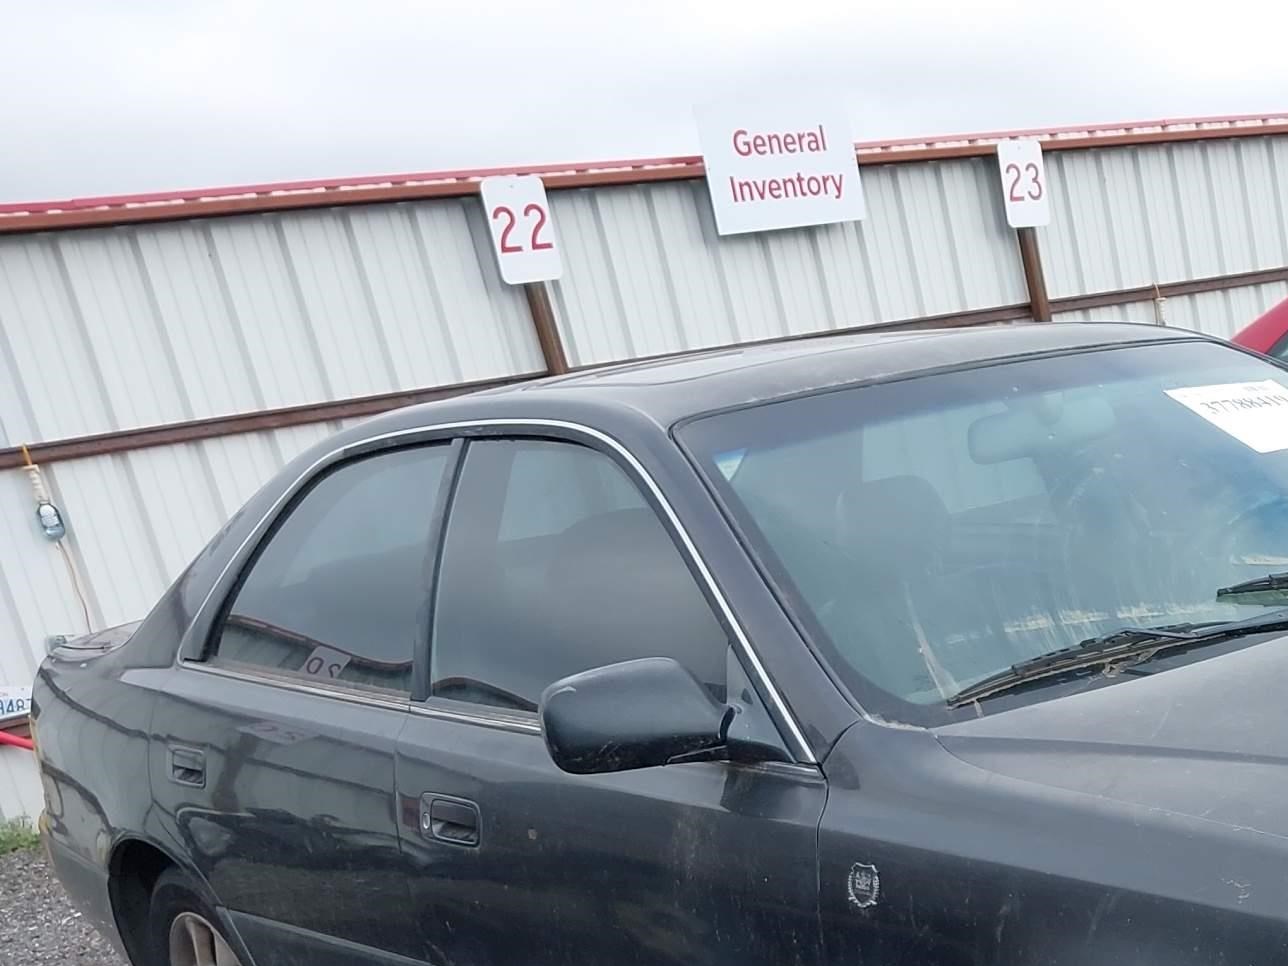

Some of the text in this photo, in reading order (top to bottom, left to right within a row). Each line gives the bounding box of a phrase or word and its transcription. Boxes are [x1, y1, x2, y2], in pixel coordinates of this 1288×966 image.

[732, 124, 827, 157] General
[729, 172, 844, 203] Inventory
[1006, 163, 1042, 202] 23
[492, 203, 554, 254] 22
